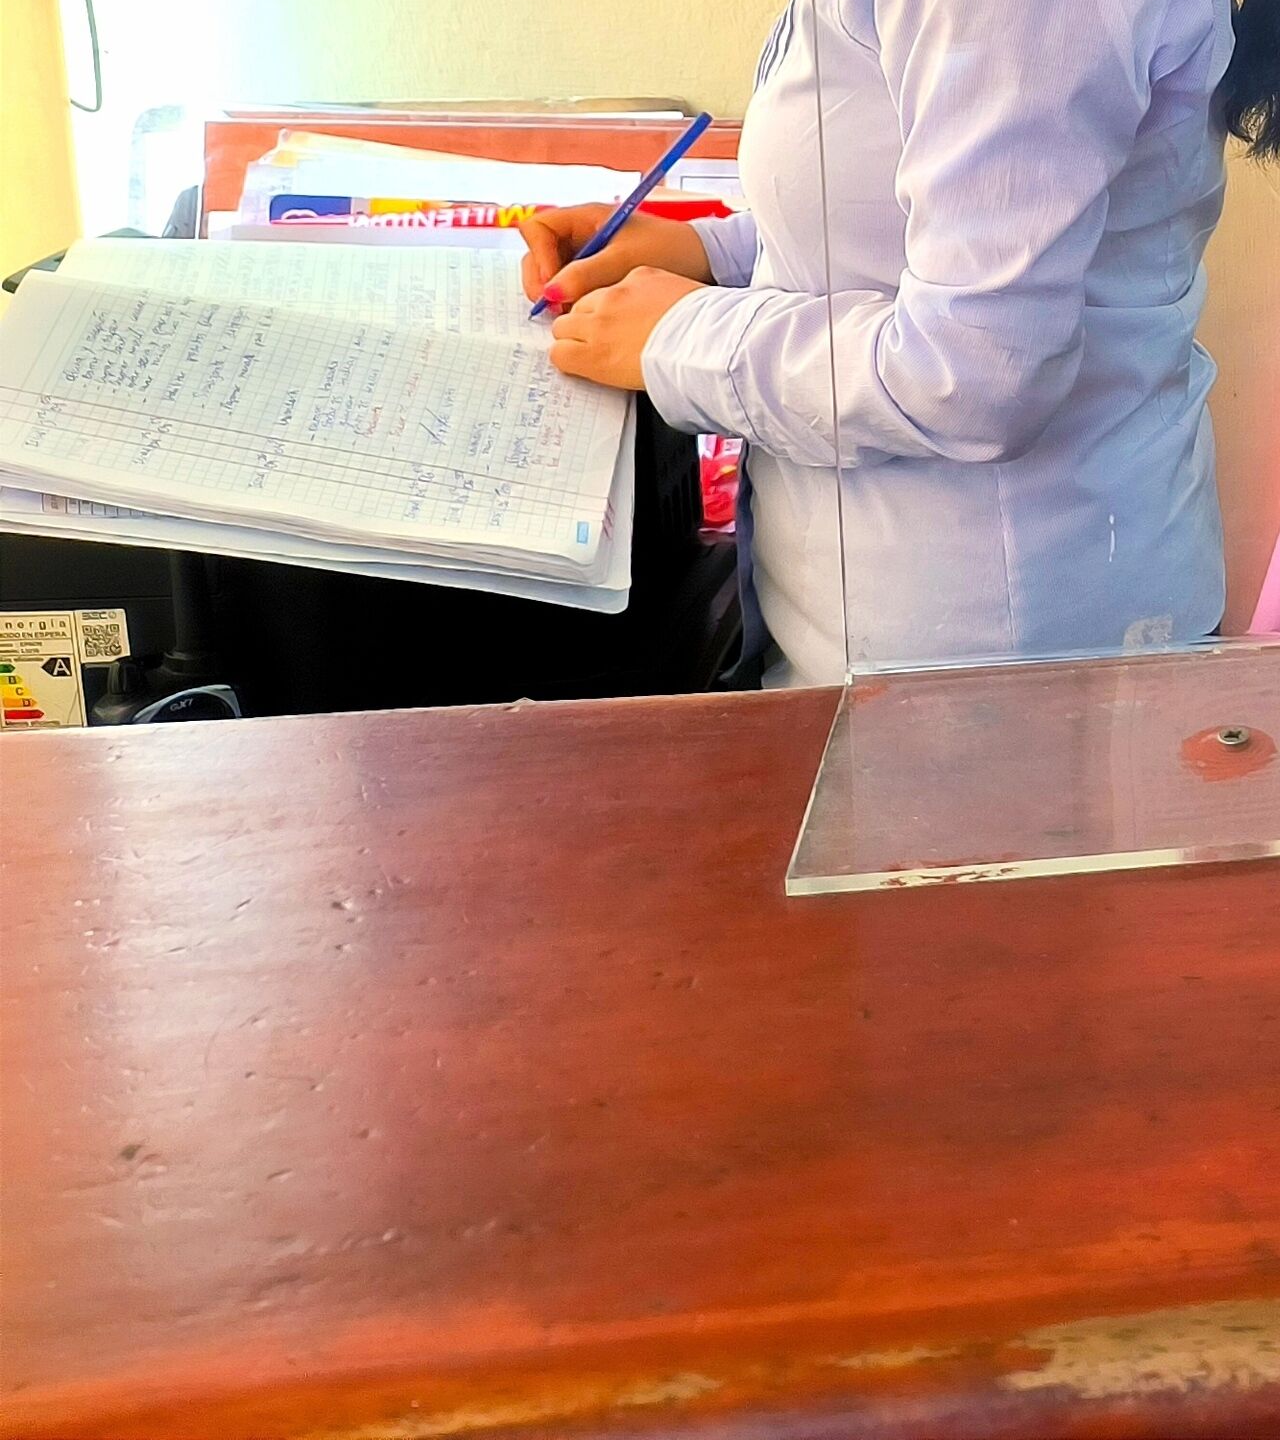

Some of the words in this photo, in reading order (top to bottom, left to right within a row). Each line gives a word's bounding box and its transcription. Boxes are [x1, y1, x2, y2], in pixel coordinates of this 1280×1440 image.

[5, 618, 66, 631] nergía
[22, 631, 33, 639] EN
[34, 631, 67, 639] ESPERA
[53, 658, 71, 676] A
[9, 676, 16, 684] B
[15, 687, 24, 696] C
[22, 698, 31, 707] D
